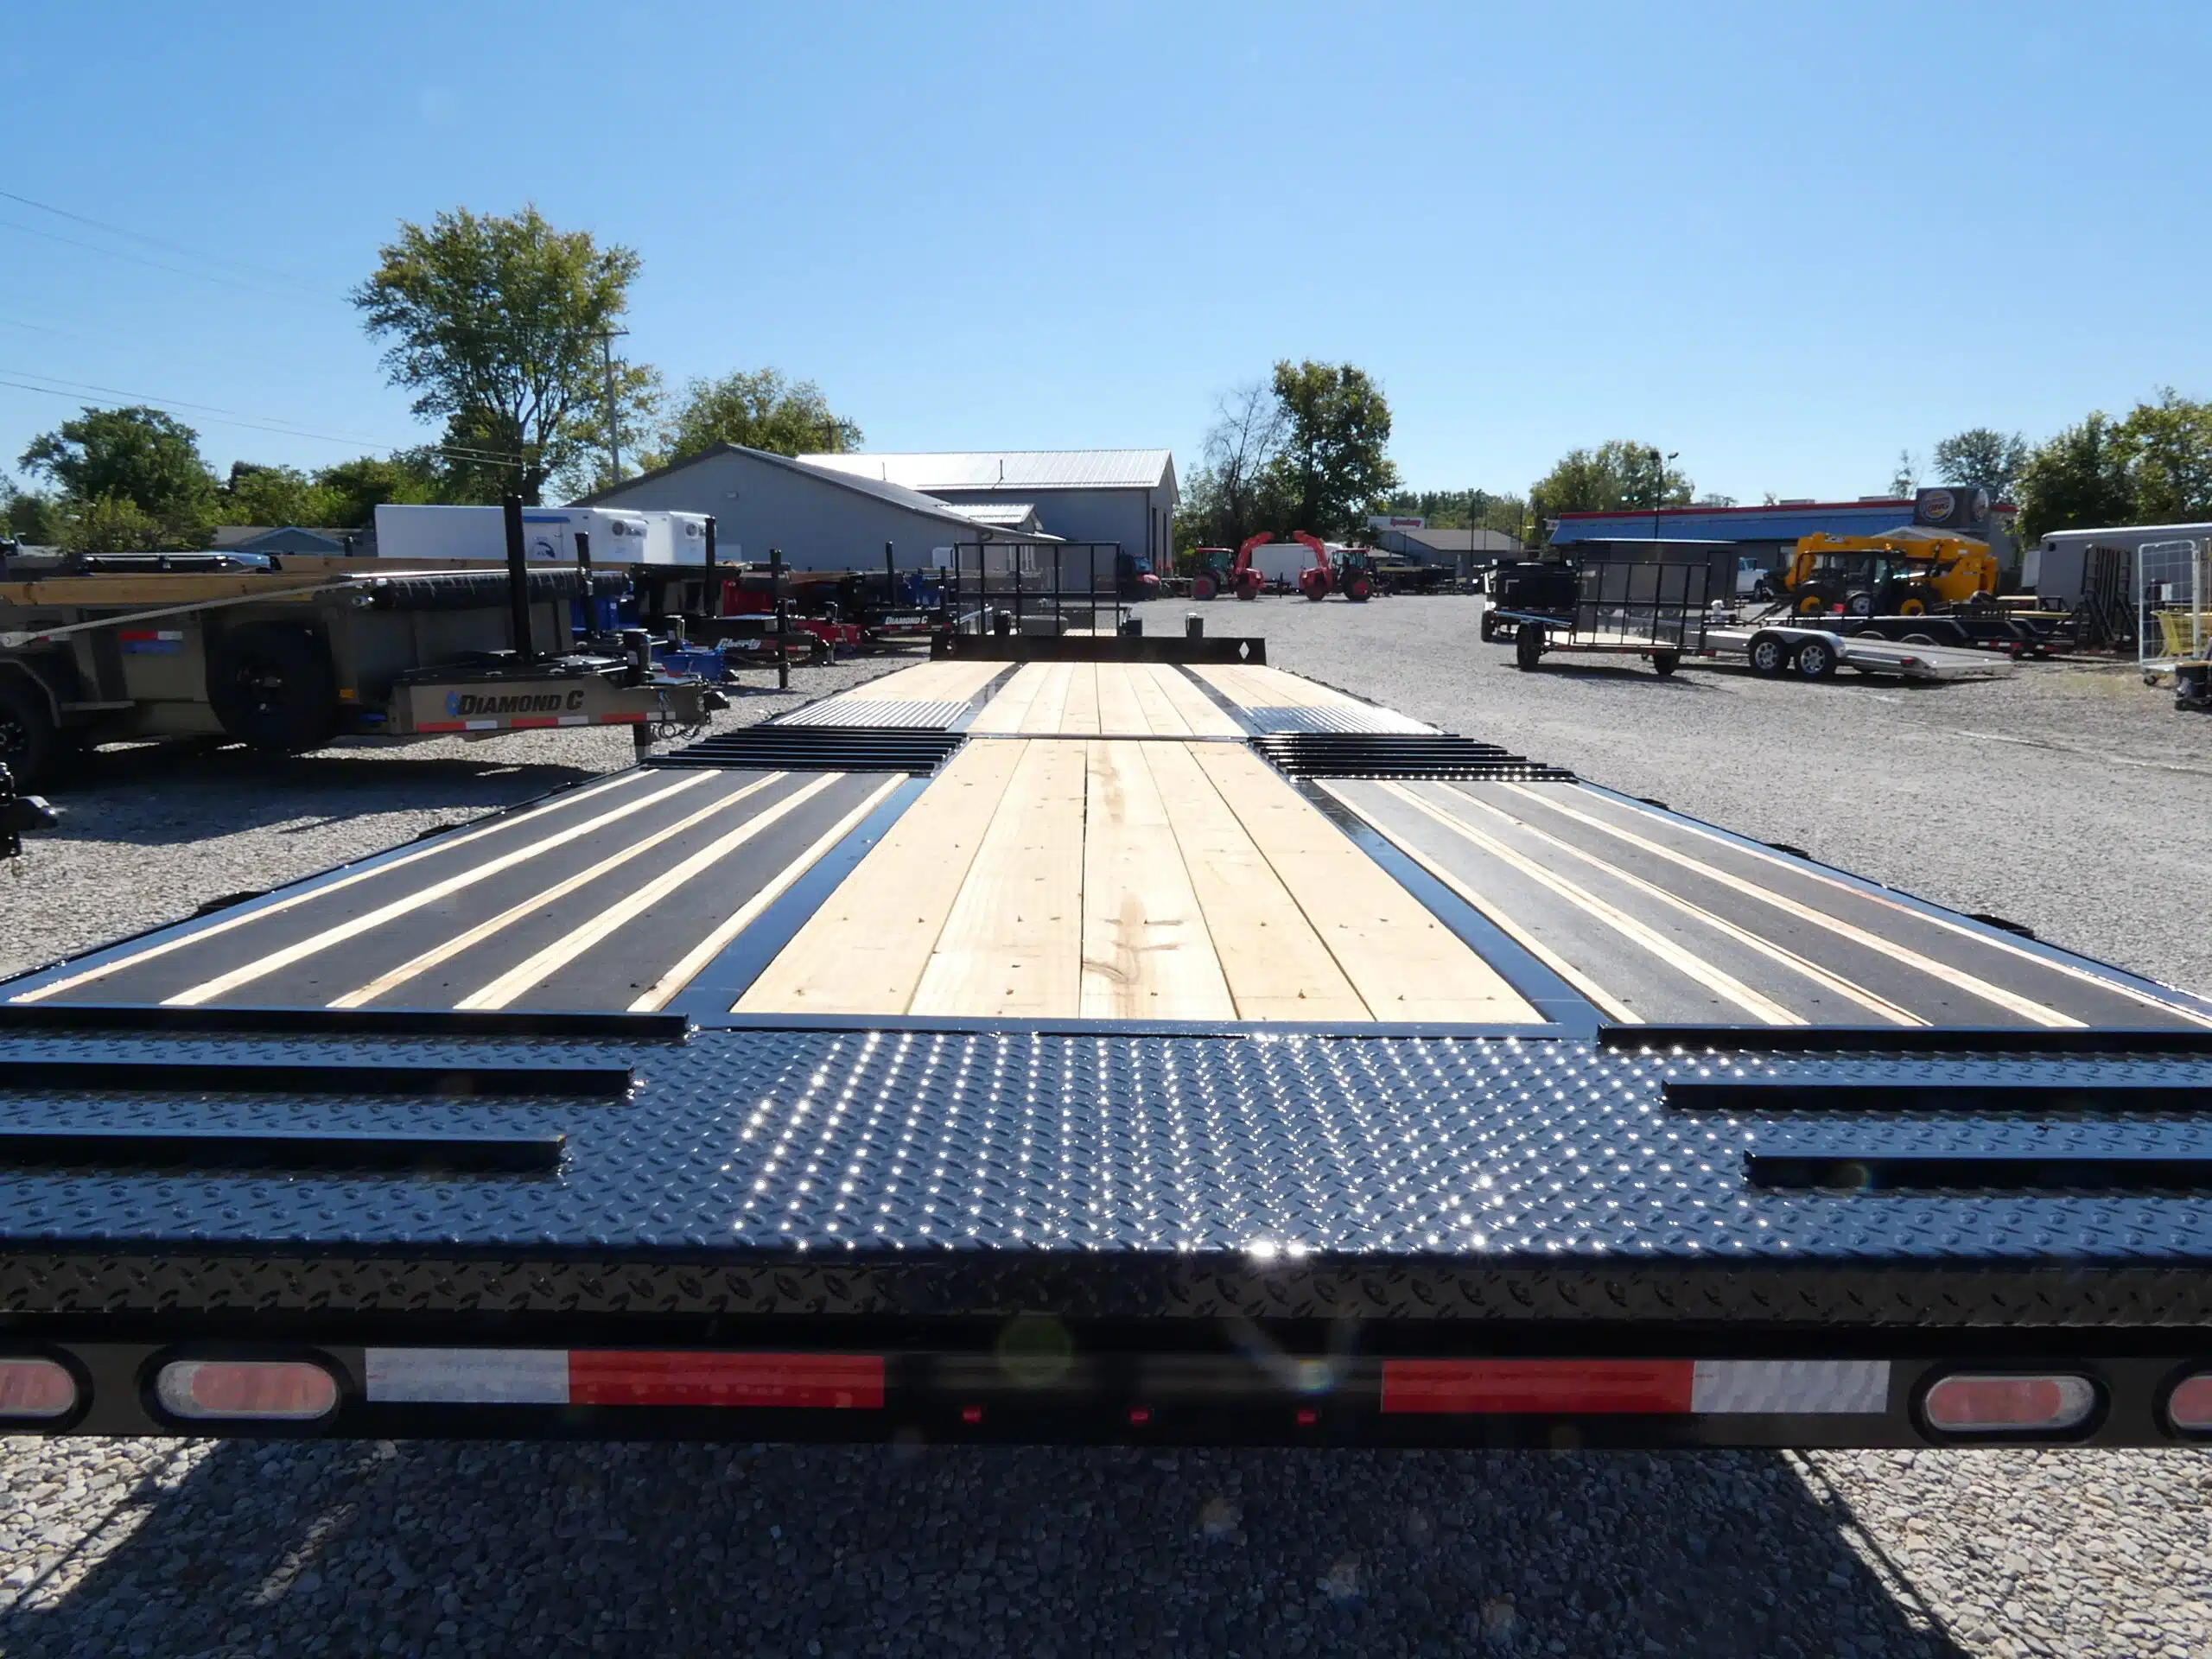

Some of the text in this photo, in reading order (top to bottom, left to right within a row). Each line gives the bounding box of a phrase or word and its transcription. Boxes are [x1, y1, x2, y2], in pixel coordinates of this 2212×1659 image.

[885, 615, 928, 625] DIAMOND C
[458, 690, 584, 715] DIAMOND C
